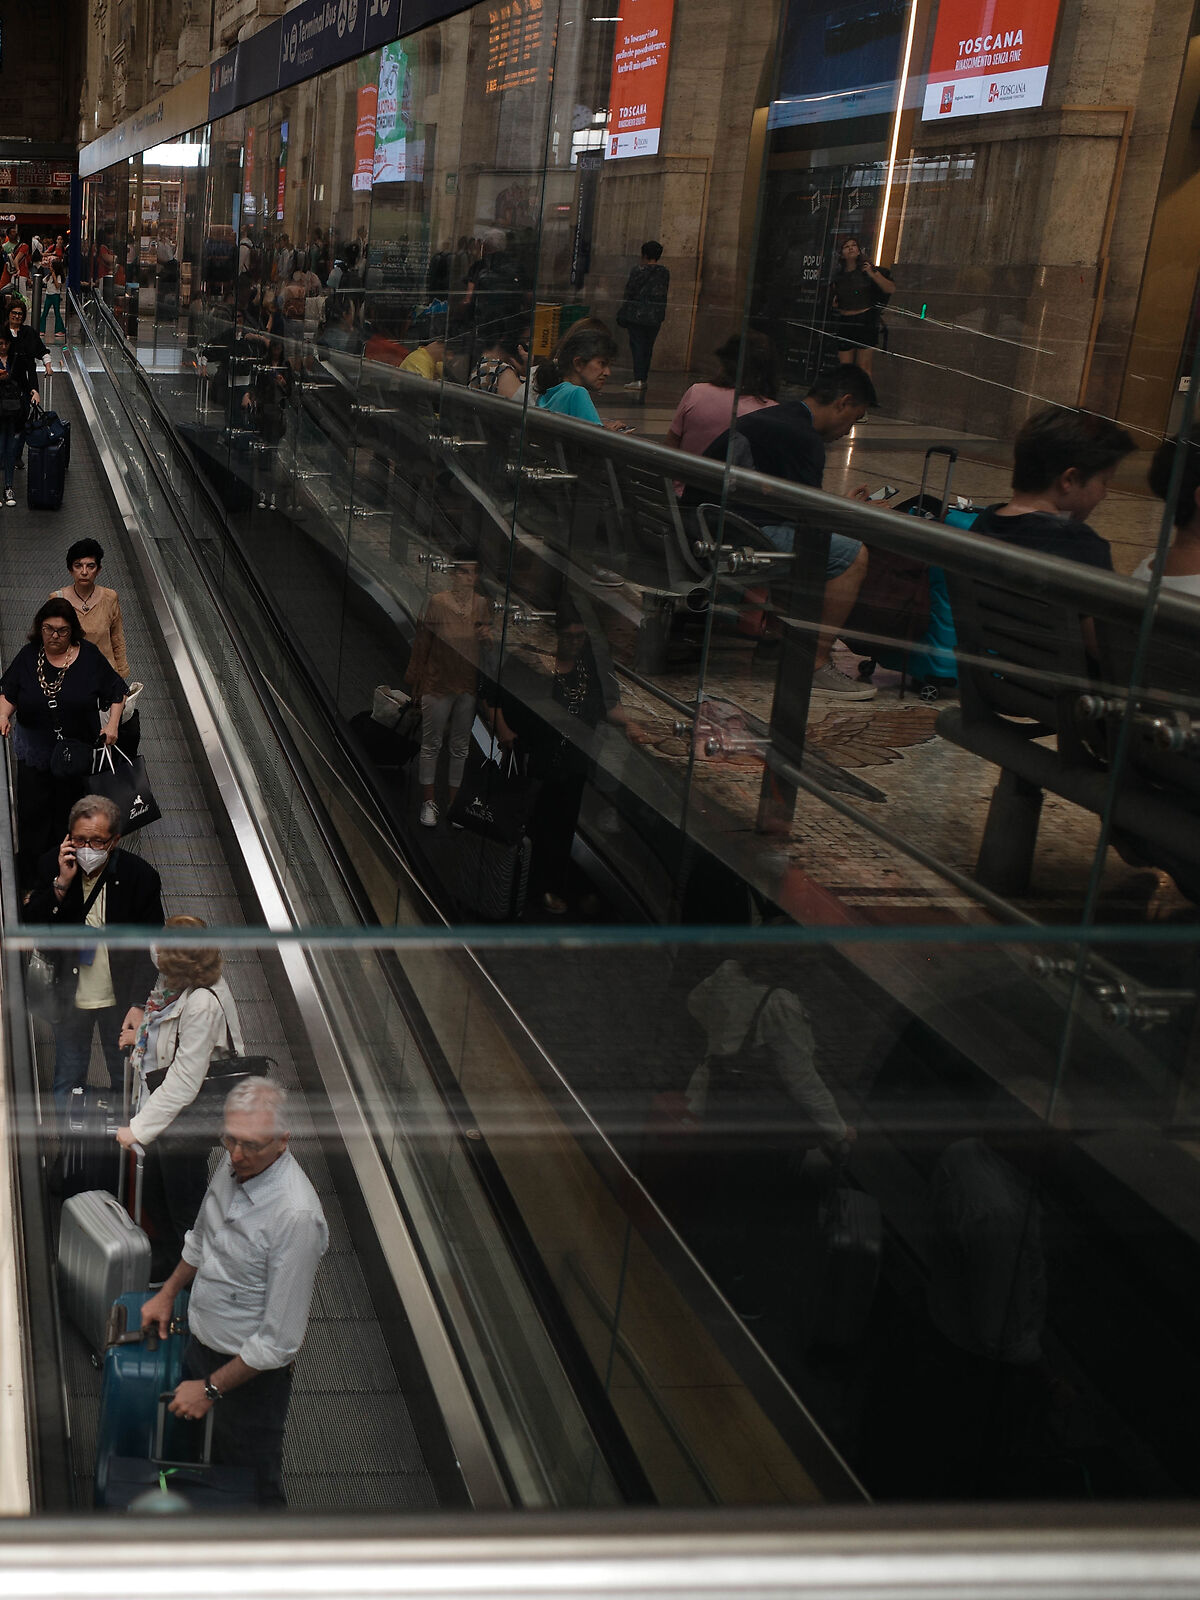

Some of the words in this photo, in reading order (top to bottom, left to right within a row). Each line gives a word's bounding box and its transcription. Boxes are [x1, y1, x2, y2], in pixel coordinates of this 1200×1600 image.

[299, 4, 326, 43] Terminal
[325, 2, 337, 28] Bus
[958, 29, 1023, 56] TOSCANA
[955, 54, 992, 71] RINASCIMENTO
[992, 52, 1009, 65] SENZA
[1009, 49, 1022, 62] FINE
[1000, 83, 1026, 96] TOSCANA
[619, 103, 647, 118] TOSCANA
[18, 174, 52, 184] FRIES
[803, 255, 816, 266] POP
[803, 269, 824, 280] STOR
